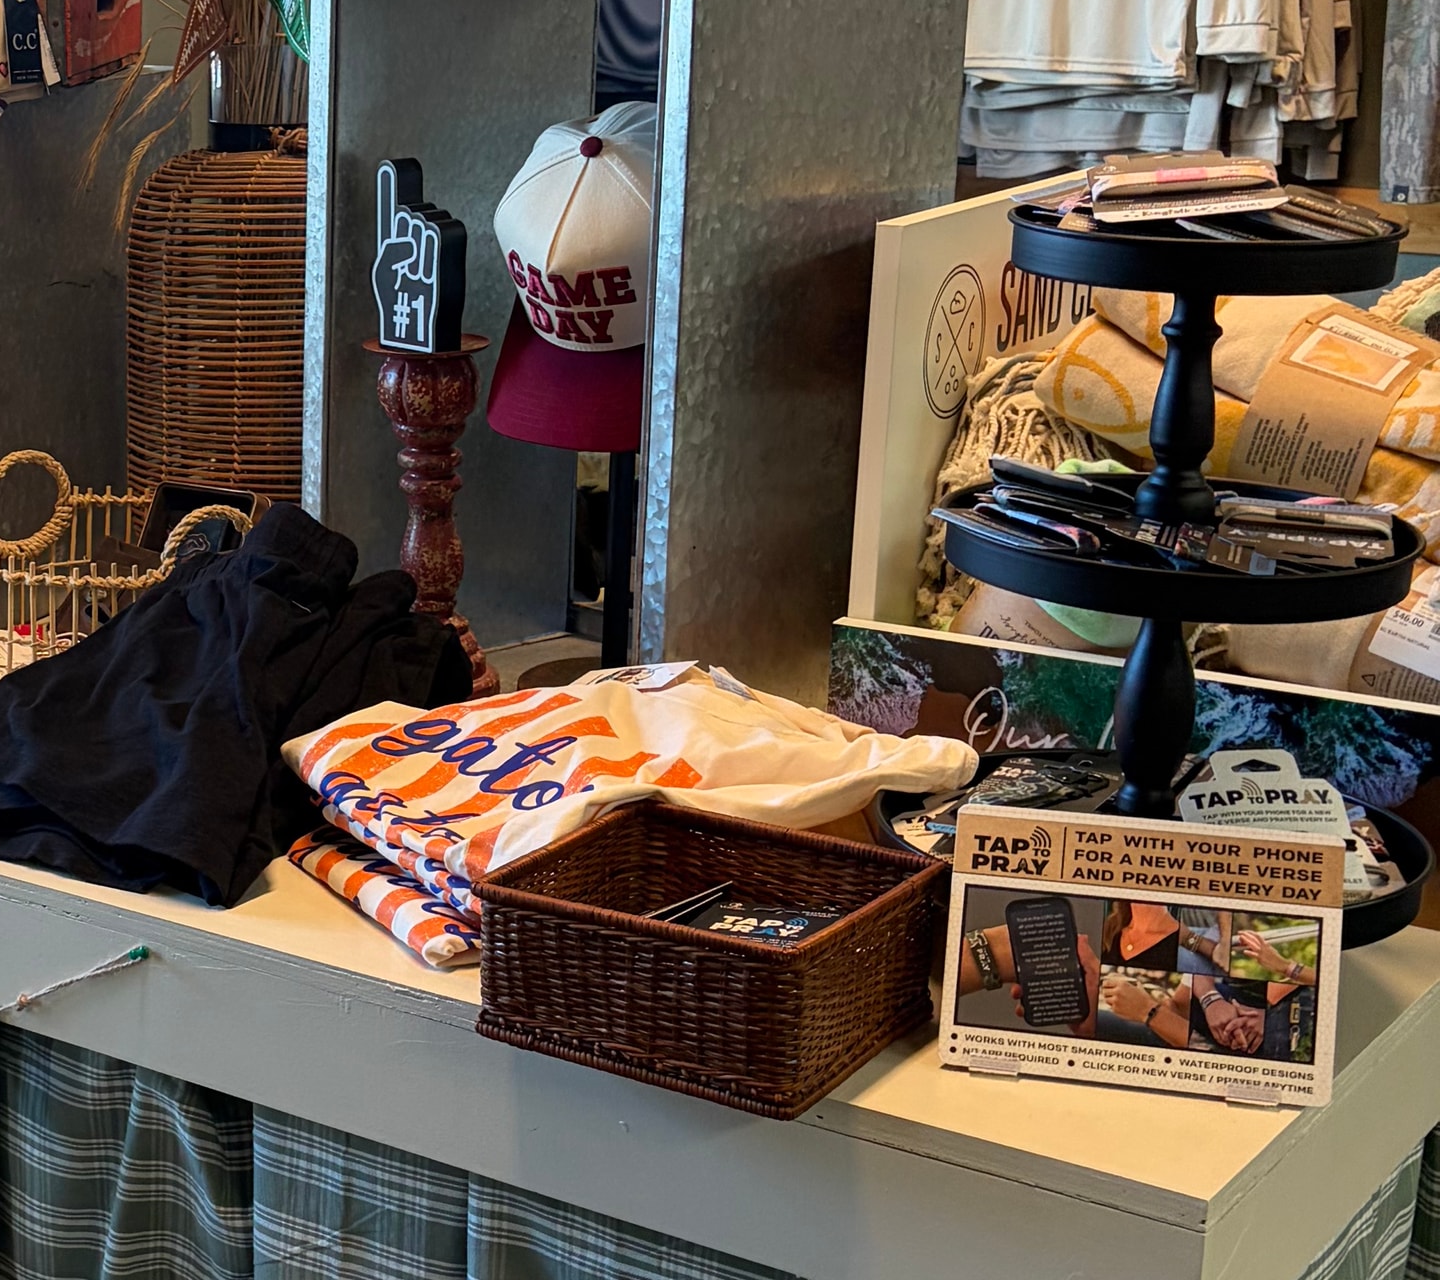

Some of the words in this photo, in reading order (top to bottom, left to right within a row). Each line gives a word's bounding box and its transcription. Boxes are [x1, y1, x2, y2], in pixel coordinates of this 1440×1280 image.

[508, 249, 637, 308] GAME
[393, 292, 425, 342] #1
[526, 295, 615, 345] DAY
[997, 260, 1062, 352] SAND
[1329, 539, 1385, 550] TAP
[1392, 610, 1425, 628] $46.00
[964, 686, 1070, 753] Our
[1188, 789, 1244, 810] TAP
[1247, 796, 1265, 805] TO
[1266, 789, 1330, 805] PRAY
[1220, 811, 1242, 819] WITH
[974, 835, 1030, 855] TAP
[1032, 848, 1051, 858] TO
[1075, 831, 1112, 845] TAP
[1124, 834, 1174, 851] WITH
[1186, 840, 1241, 857] YOUR
[1253, 847, 1324, 864] PHONE
[972, 853, 1050, 876] PRAY
[1074, 849, 1113, 864] FOR
[1120, 853, 1133, 866] A
[1140, 855, 1186, 870] NEW
[1192, 860, 1250, 876] BIBLE
[1256, 865, 1323, 882] VERSE
[1072, 867, 1114, 882] AND
[1122, 871, 1200, 890] PRAYER
[1208, 879, 1274, 896] EVERY
[1282, 886, 1322, 901] DAY
[709, 922, 800, 938] PRAY
[722, 915, 785, 928] TAP
[965, 1033, 1005, 1046] WORKS
[1007, 1037, 1036, 1049] WITH
[1038, 1042, 1069, 1053] MOST
[1071, 1046, 1156, 1063] SMARTPHONES
[1179, 1058, 1260, 1074] WATERPROOF
[1262, 1067, 1315, 1081] DESIGNS
[1083, 1060, 1115, 1072] CLICK
[1117, 1065, 1139, 1075] FOR
[1142, 1067, 1168, 1078] NEW
[1170, 1071, 1207, 1082] VERSE
